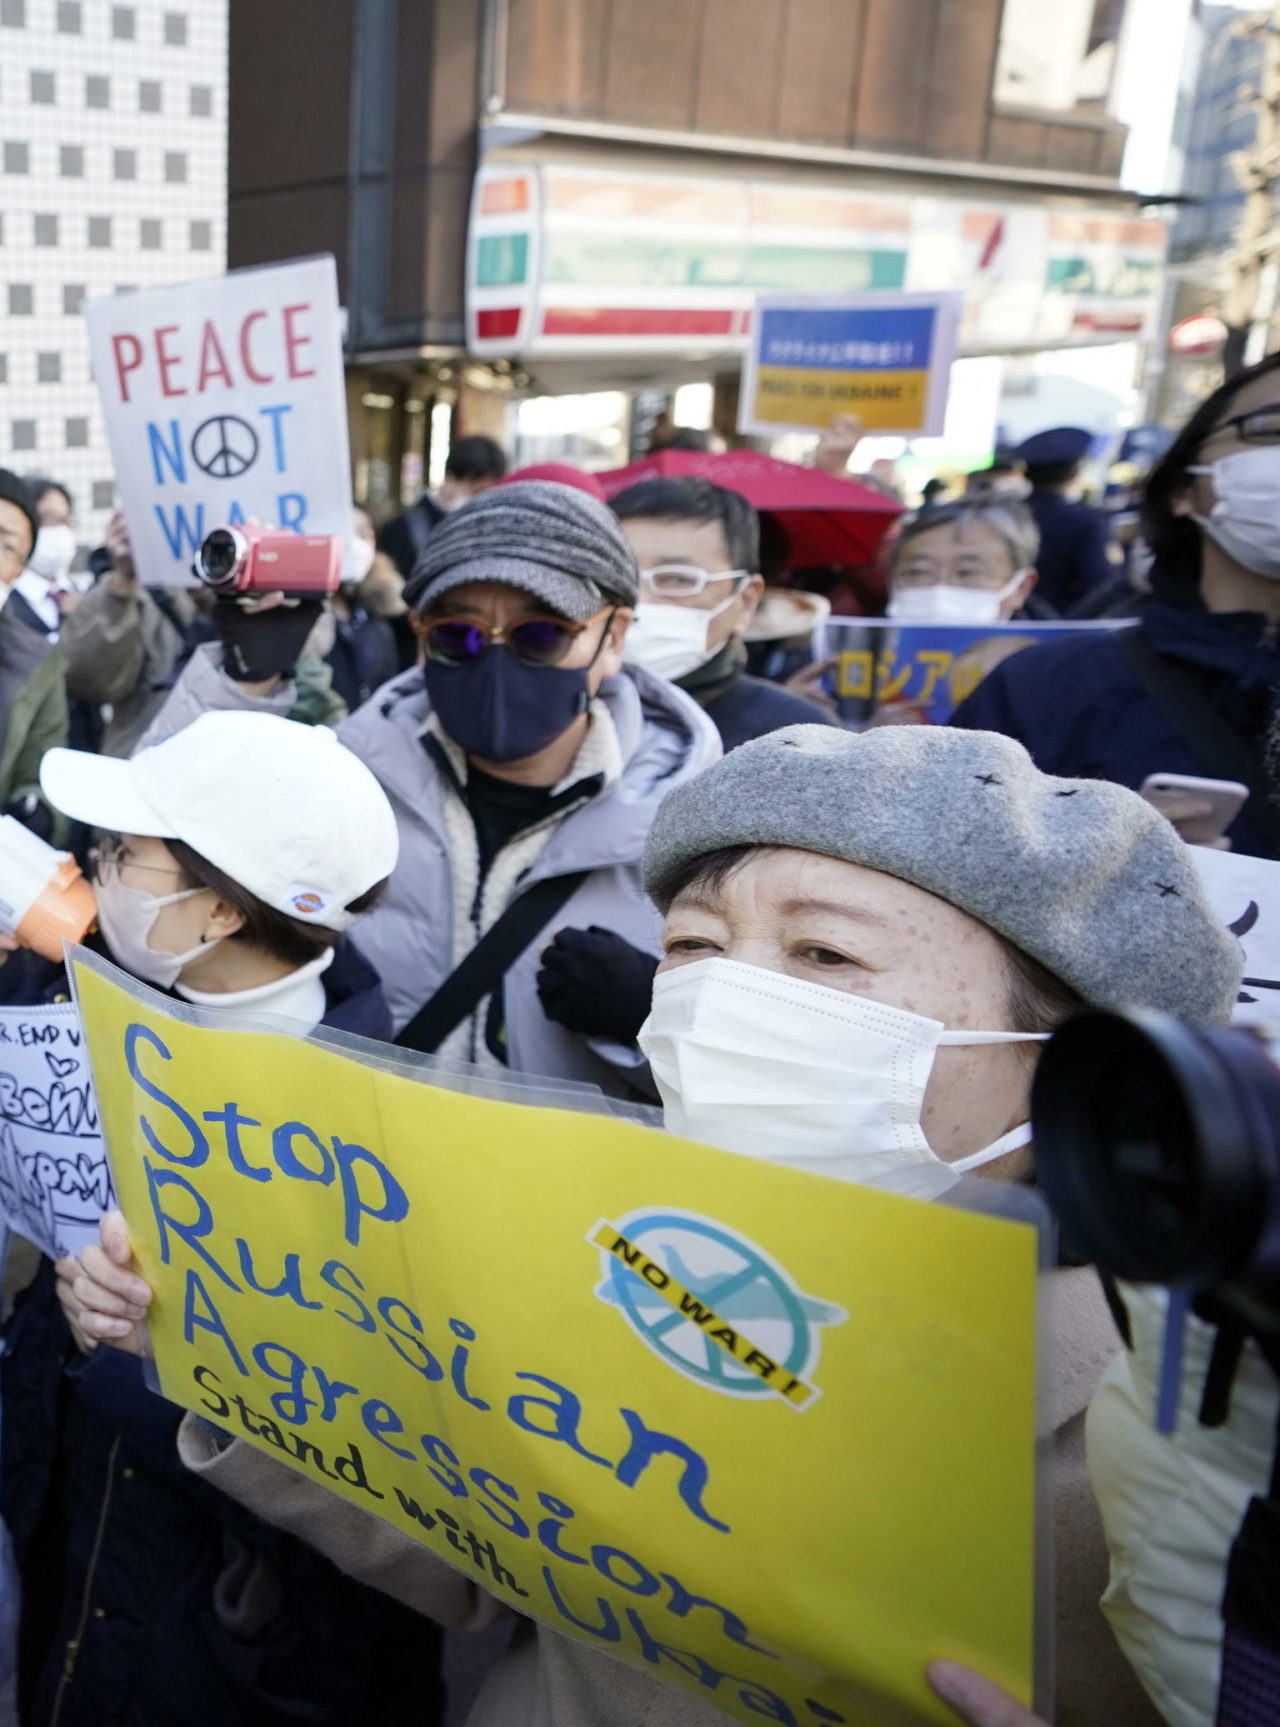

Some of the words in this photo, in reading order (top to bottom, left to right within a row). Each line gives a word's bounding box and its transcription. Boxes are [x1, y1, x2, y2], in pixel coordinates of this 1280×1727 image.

[112, 302, 317, 403] PEACE
[19, 1024, 60, 1047] END
[124, 1023, 410, 1247] Stop
[143, 1156, 731, 1533] Russian
[611, 1237, 671, 1290] NO
[679, 1292, 800, 1396] WAR!
[183, 1268, 782, 1661] Agression
[193, 1365, 385, 1500] Stand
[393, 1486, 530, 1598] with
